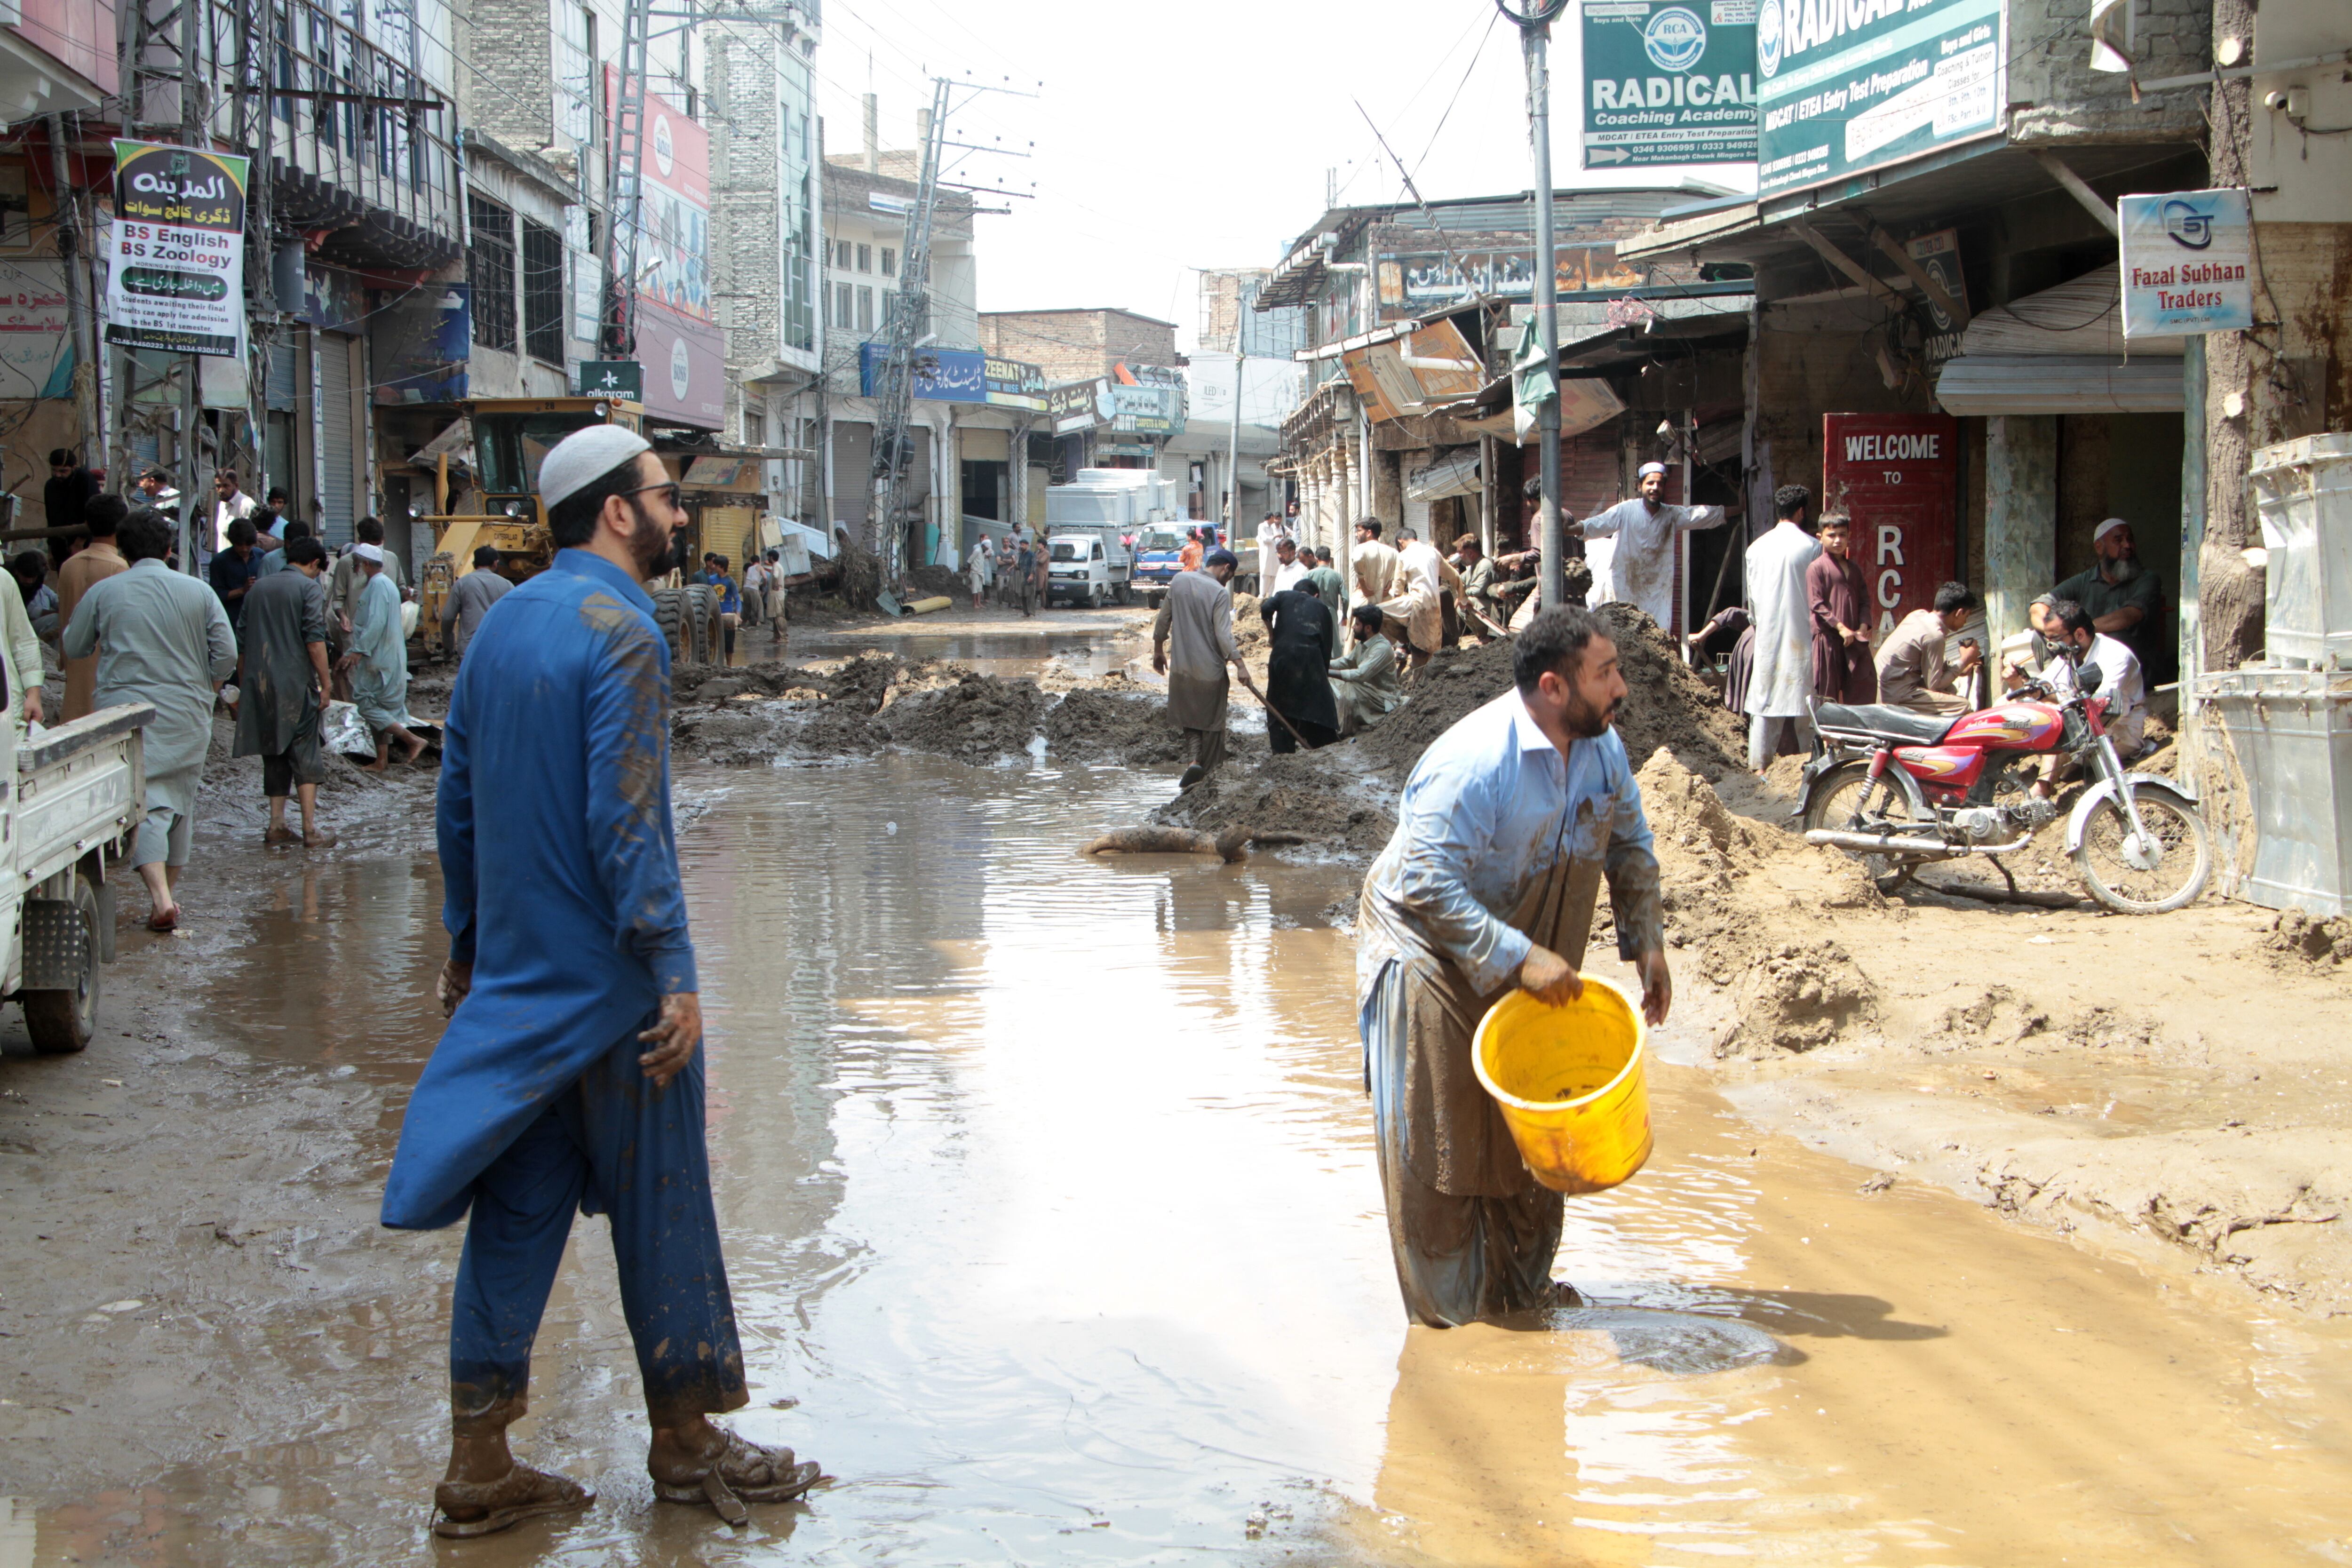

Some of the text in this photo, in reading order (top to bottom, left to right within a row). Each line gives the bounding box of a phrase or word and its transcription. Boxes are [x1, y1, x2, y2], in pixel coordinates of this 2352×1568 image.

[1663, 24, 1687, 34] RCA
[1784, 0, 1902, 58] RADIC
[1941, 24, 1991, 55] Boys and Girls
[1938, 50, 1992, 77] Coaching & Tuition
[1948, 76, 1970, 89] Classes
[1593, 73, 1757, 110] RADICAL
[1765, 58, 1928, 132] MDCAT ETEA Entry Test Preparation
[1595, 108, 1757, 126] Coaching Academy
[1961, 109, 1971, 121] Part
[1597, 133, 1628, 142] MDCAT
[1661, 131, 1684, 140] Entry
[1707, 128, 1757, 138] Preparation
[657, 136, 671, 160] BOSS
[1657, 144, 1694, 152] 9306995
[125, 201, 162, 217] سوات
[165, 206, 191, 220] کالج
[194, 208, 230, 224] ڈگری
[125, 224, 229, 248] BS English
[121, 241, 231, 269] BS Zoology
[2132, 263, 2245, 287] Fazal Subhan
[152, 275, 178, 294] جاری
[177, 278, 202, 291] داخلہ
[203, 280, 220, 295] میں
[121, 294, 151, 305] Students
[154, 301, 186, 310] awaiting
[208, 304, 226, 312] final
[2157, 289, 2222, 309] Traders
[117, 306, 141, 315] results
[191, 314, 229, 323] admission
[178, 323, 213, 332] semester.
[177, 345, 229, 354] 0334-9304140
[1924, 332, 1966, 361] RADICA
[674, 363, 686, 382] BOSS
[985, 359, 1019, 381] ZEENAT
[587, 388, 634, 399] alkaram
[986, 380, 1019, 393] TRUNK HOUSE
[1136, 418, 1153, 429] CARPETS
[1154, 419, 1158, 429] &
[1159, 420, 1169, 429] FOAM
[1845, 434, 1939, 462] WELCOME
[1883, 471, 1901, 484] TO
[1900, 749, 1925, 758] SP70
